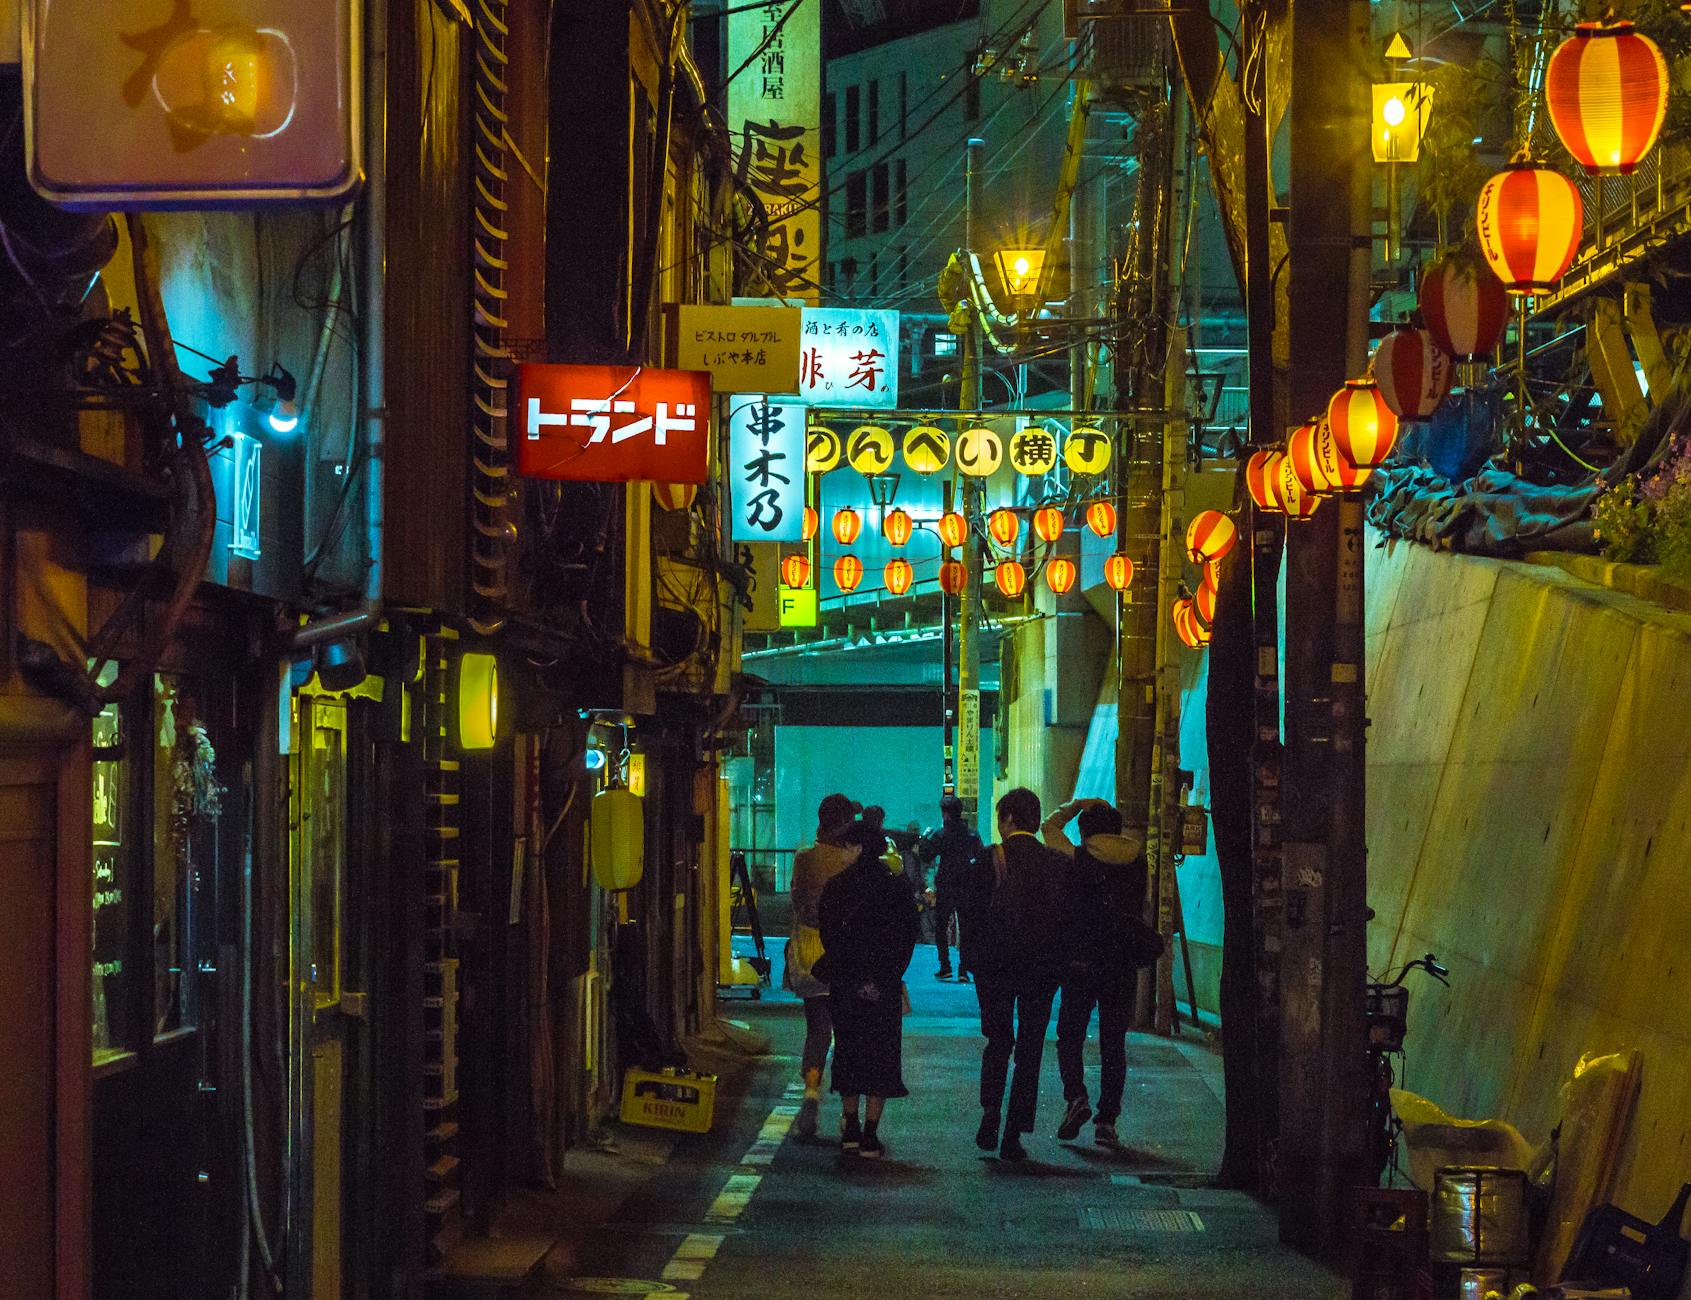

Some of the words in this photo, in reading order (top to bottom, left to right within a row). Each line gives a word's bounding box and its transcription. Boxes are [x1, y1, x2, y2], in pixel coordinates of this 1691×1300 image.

[695, 329, 736, 343] ビストロ
[703, 348, 767, 367] しぶや本店
[528, 398, 695, 445] トランド
[643, 1102, 686, 1118] KIRIN
